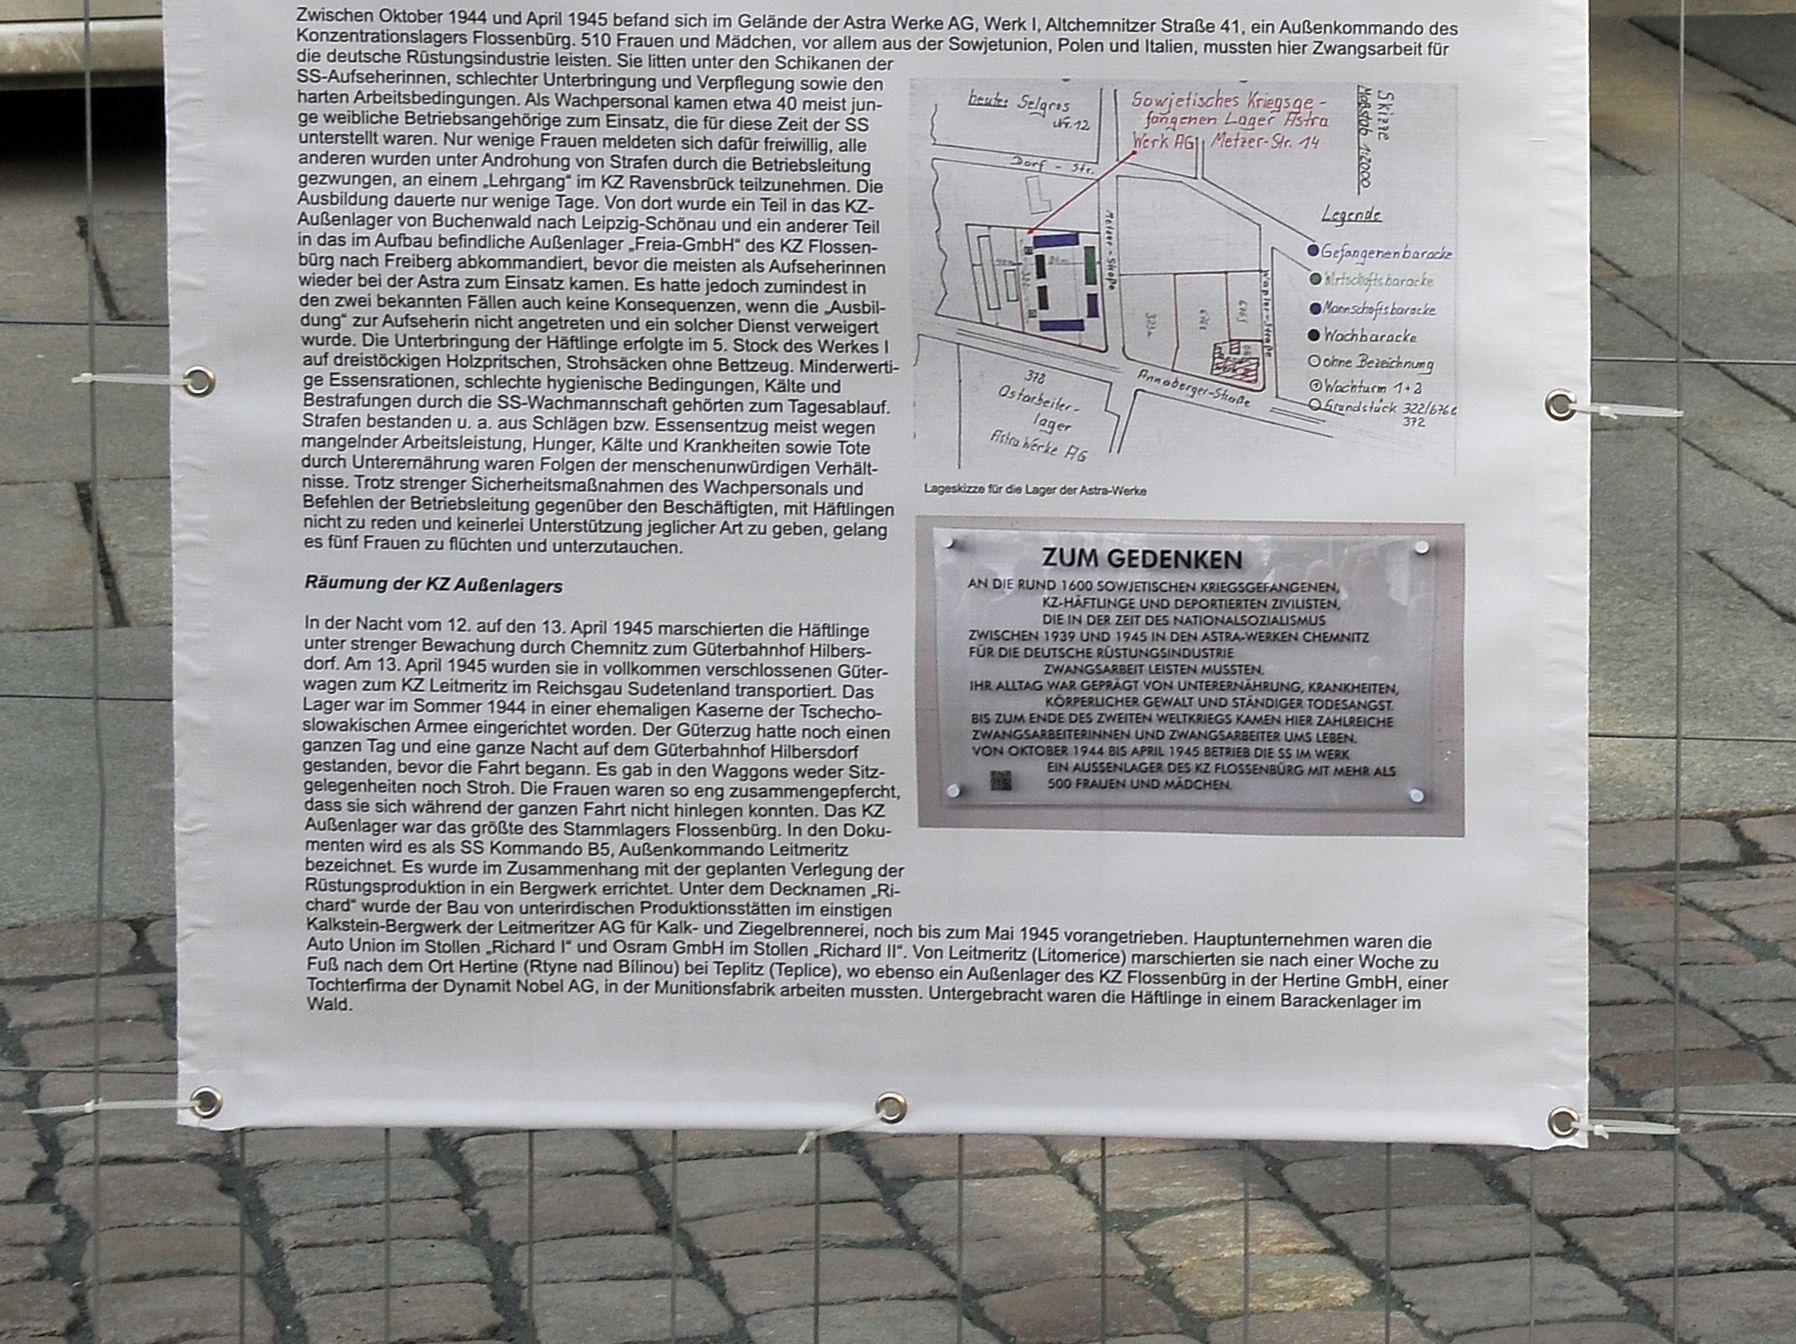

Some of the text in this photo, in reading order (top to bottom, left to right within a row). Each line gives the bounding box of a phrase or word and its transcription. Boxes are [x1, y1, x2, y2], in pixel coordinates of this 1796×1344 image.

[1132, 90, 1239, 114] Sowjetisches
[1225, 113, 1276, 131] Lager
[1283, 112, 1329, 128] Astra
[1133, 132, 1168, 149] Werk
[1174, 133, 1195, 150] AG
[1299, 136, 1320, 149] 14
[1321, 204, 1383, 227] Legende
[1324, 327, 1418, 343] Wachbaracke
[1356, 353, 1435, 375] Bezeichnung
[924, 482, 1147, 497] Lageskizze für die Lager der Astra-Werke
[1042, 546, 1243, 570] ZUM GEDENKEN
[304, 574, 563, 596] Räumung der KZ Außenlagers
[1047, 775, 1232, 790] 500 FRAUEN UND MÄDCHEN.
[306, 996, 352, 1011] Wald.
